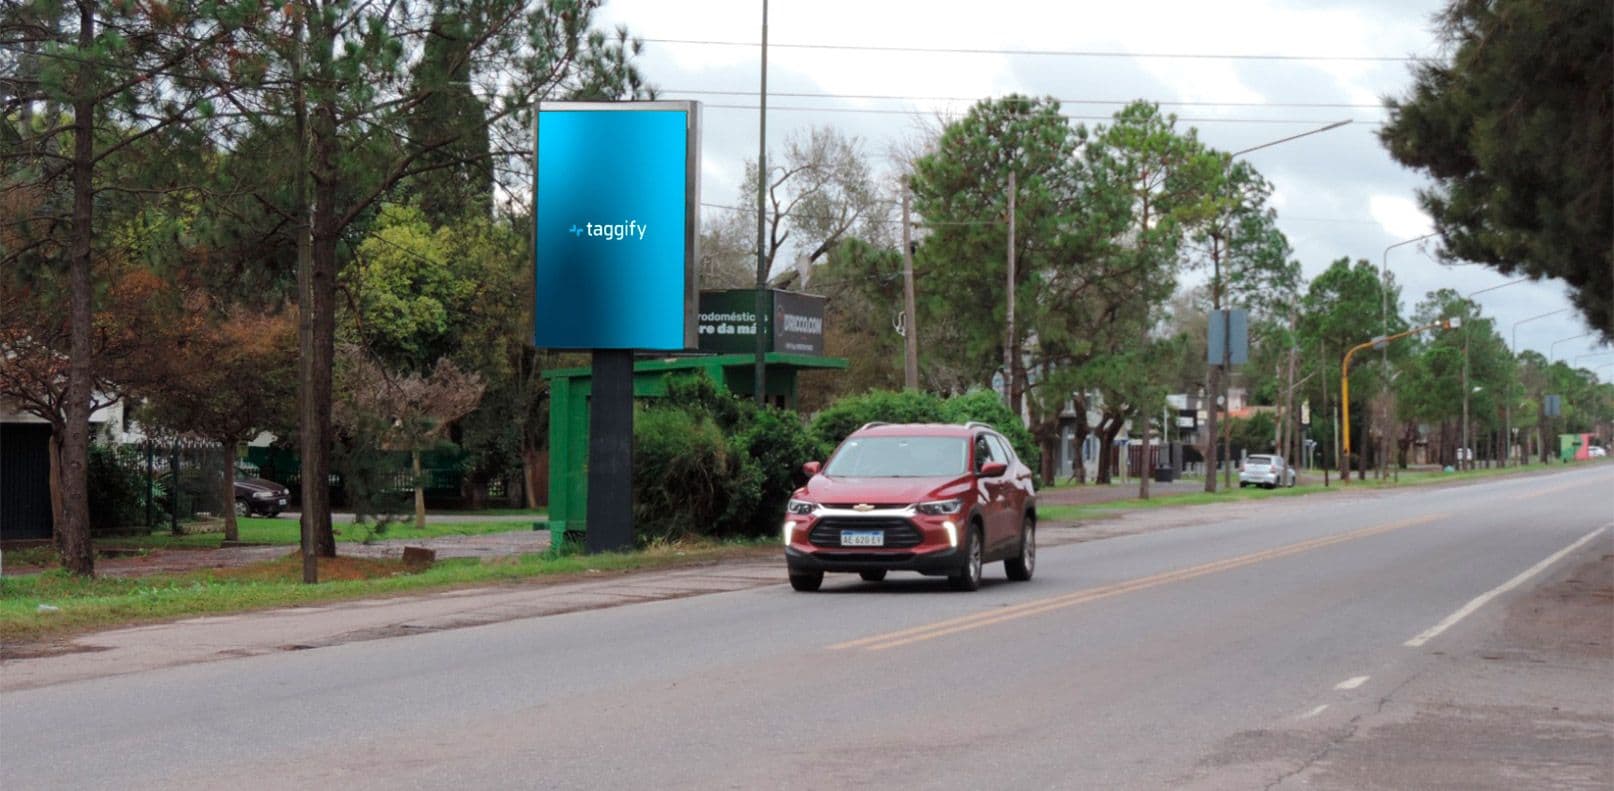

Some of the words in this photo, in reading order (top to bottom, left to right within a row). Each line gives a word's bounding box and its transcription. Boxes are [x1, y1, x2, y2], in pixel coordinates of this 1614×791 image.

[586, 219, 647, 240] taggify
[717, 322, 735, 334] da
[737, 322, 767, 334] má
